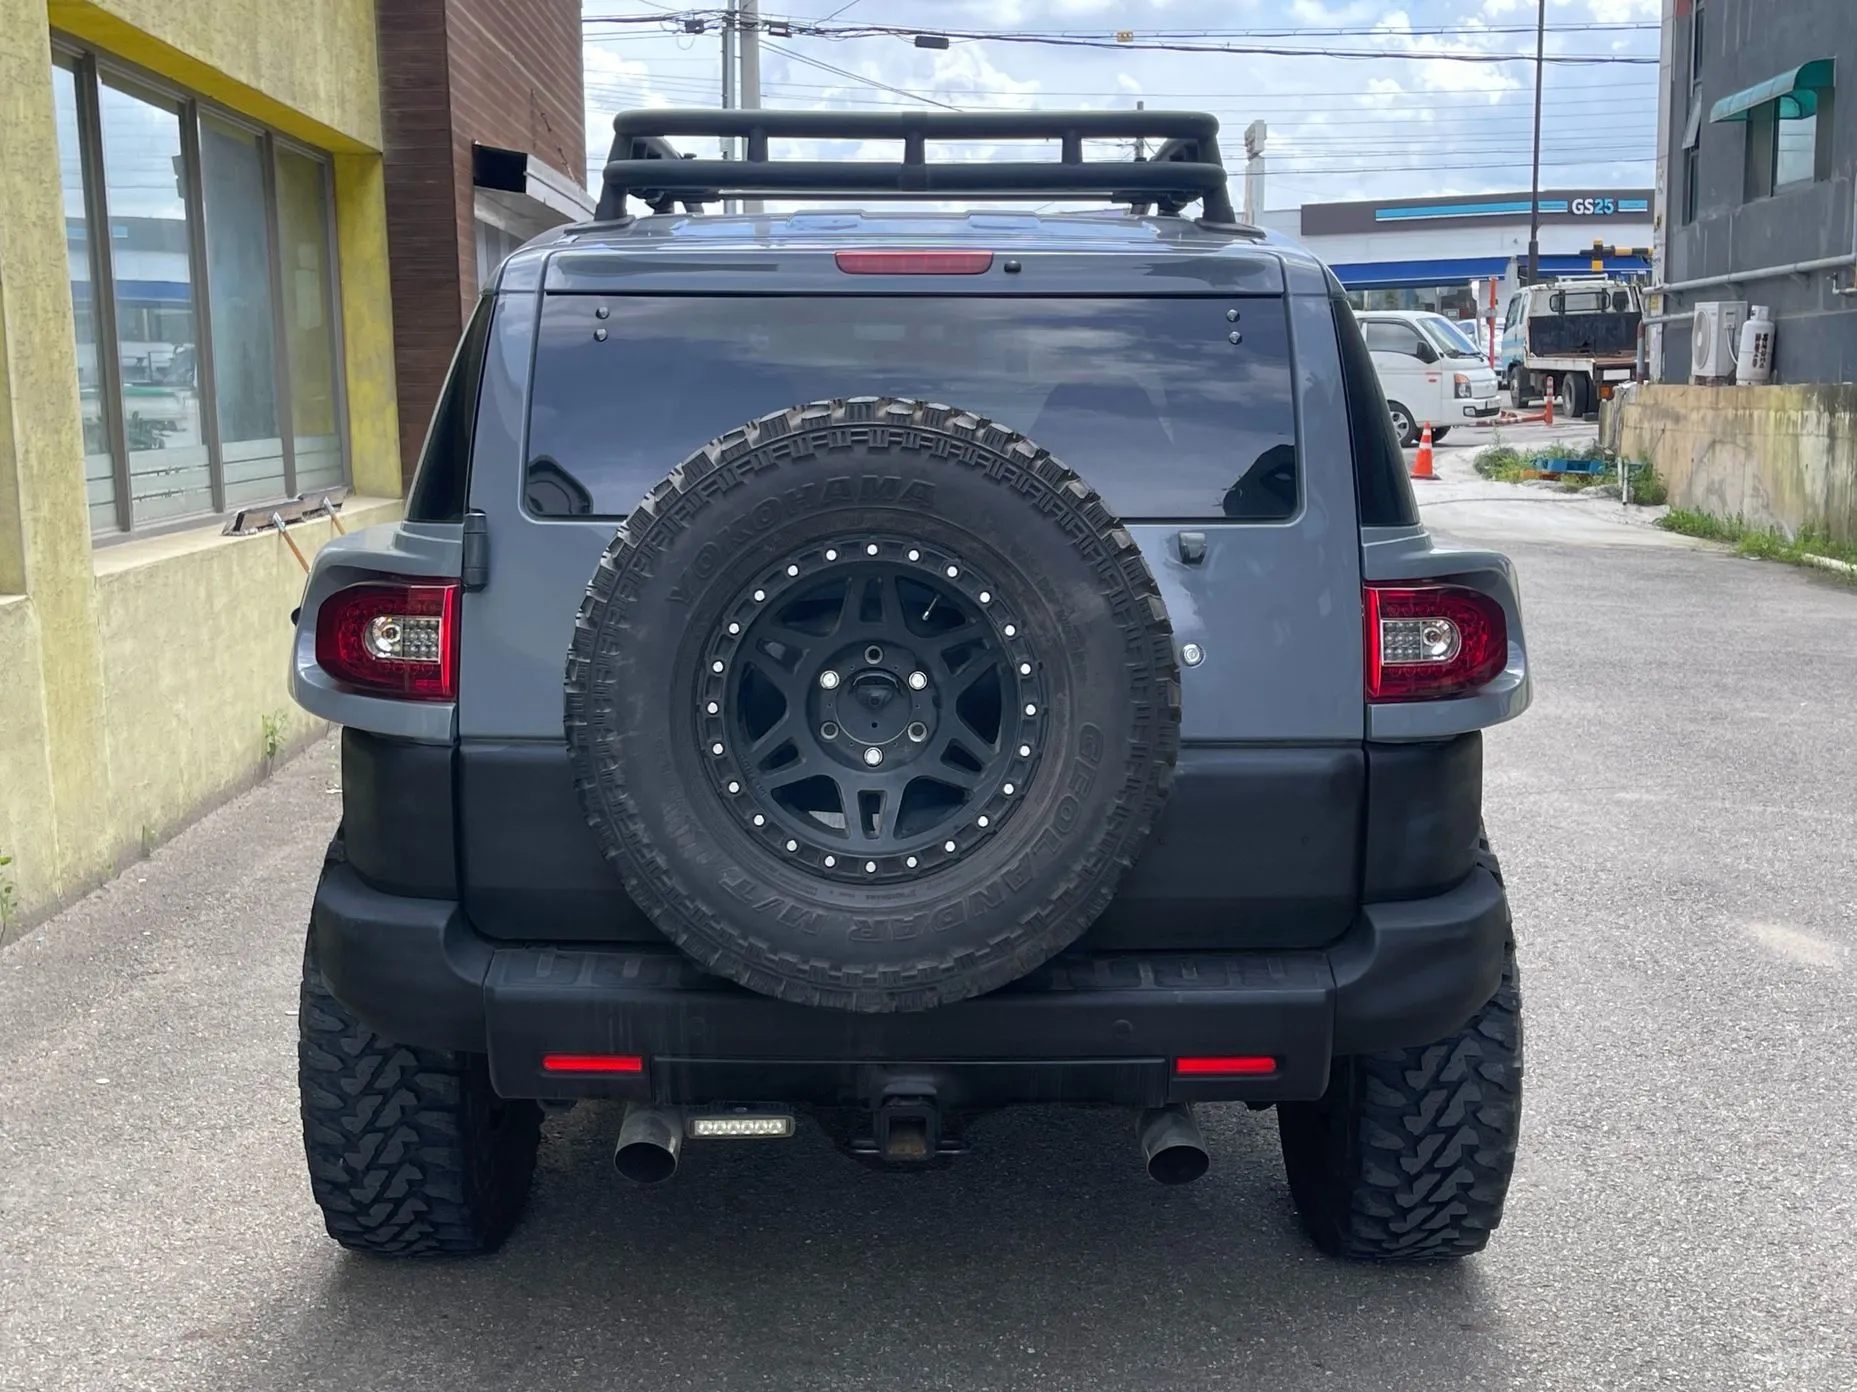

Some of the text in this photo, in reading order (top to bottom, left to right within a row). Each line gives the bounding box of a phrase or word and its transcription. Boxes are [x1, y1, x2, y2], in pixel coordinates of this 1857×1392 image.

[1571, 198, 1614, 215] GS25
[666, 475, 937, 607] YOKOHAMA
[846, 721, 1105, 944] GEOLANDAR
[718, 867, 829, 936] M/T
